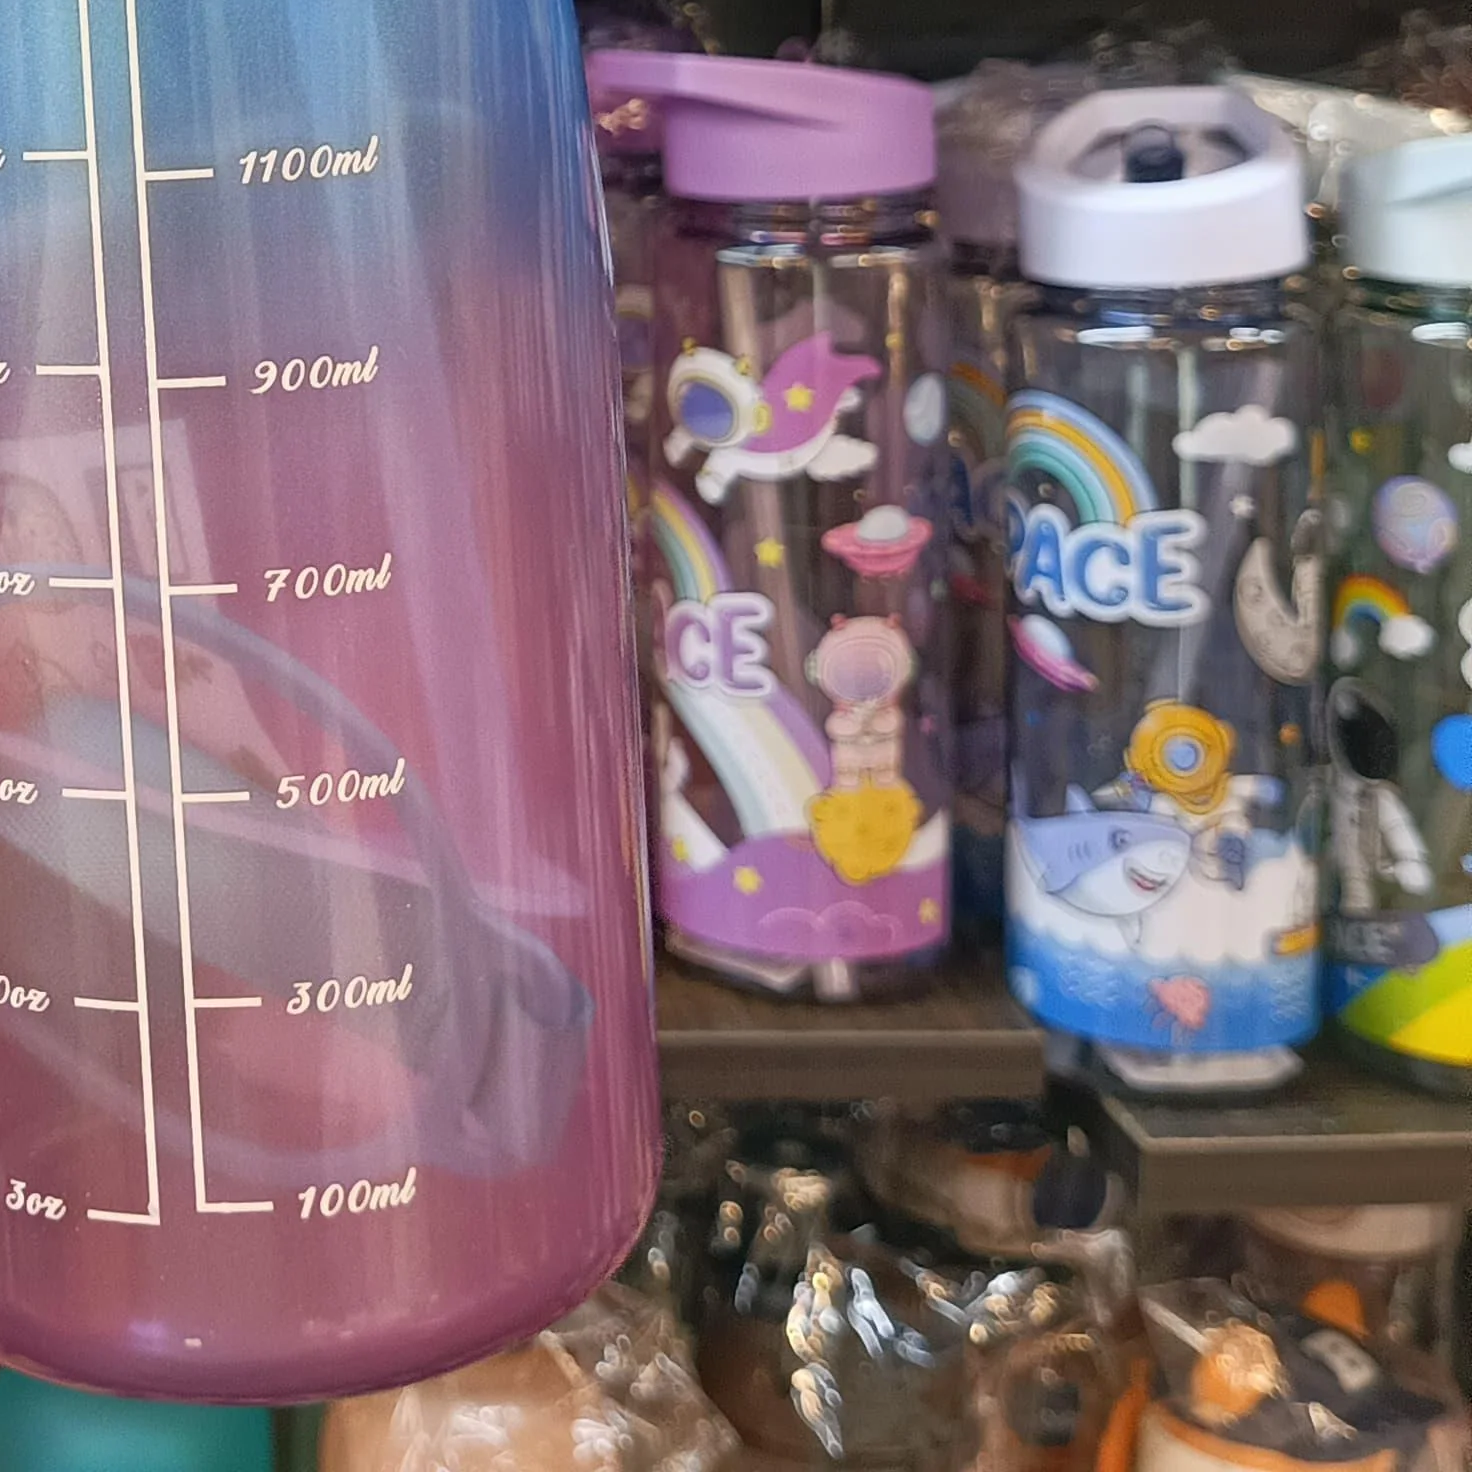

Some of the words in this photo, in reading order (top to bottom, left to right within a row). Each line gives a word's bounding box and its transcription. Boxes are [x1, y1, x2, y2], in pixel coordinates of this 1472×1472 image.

[239, 135, 379, 185] 1100ml
[250, 345, 379, 394] 900ml
[263, 552, 392, 602] 700ml
[276, 757, 406, 809] 500ml
[286, 963, 413, 1015] 300ml
[5, 1178, 67, 1221] 3oz
[298, 1166, 417, 1220] 100ml
